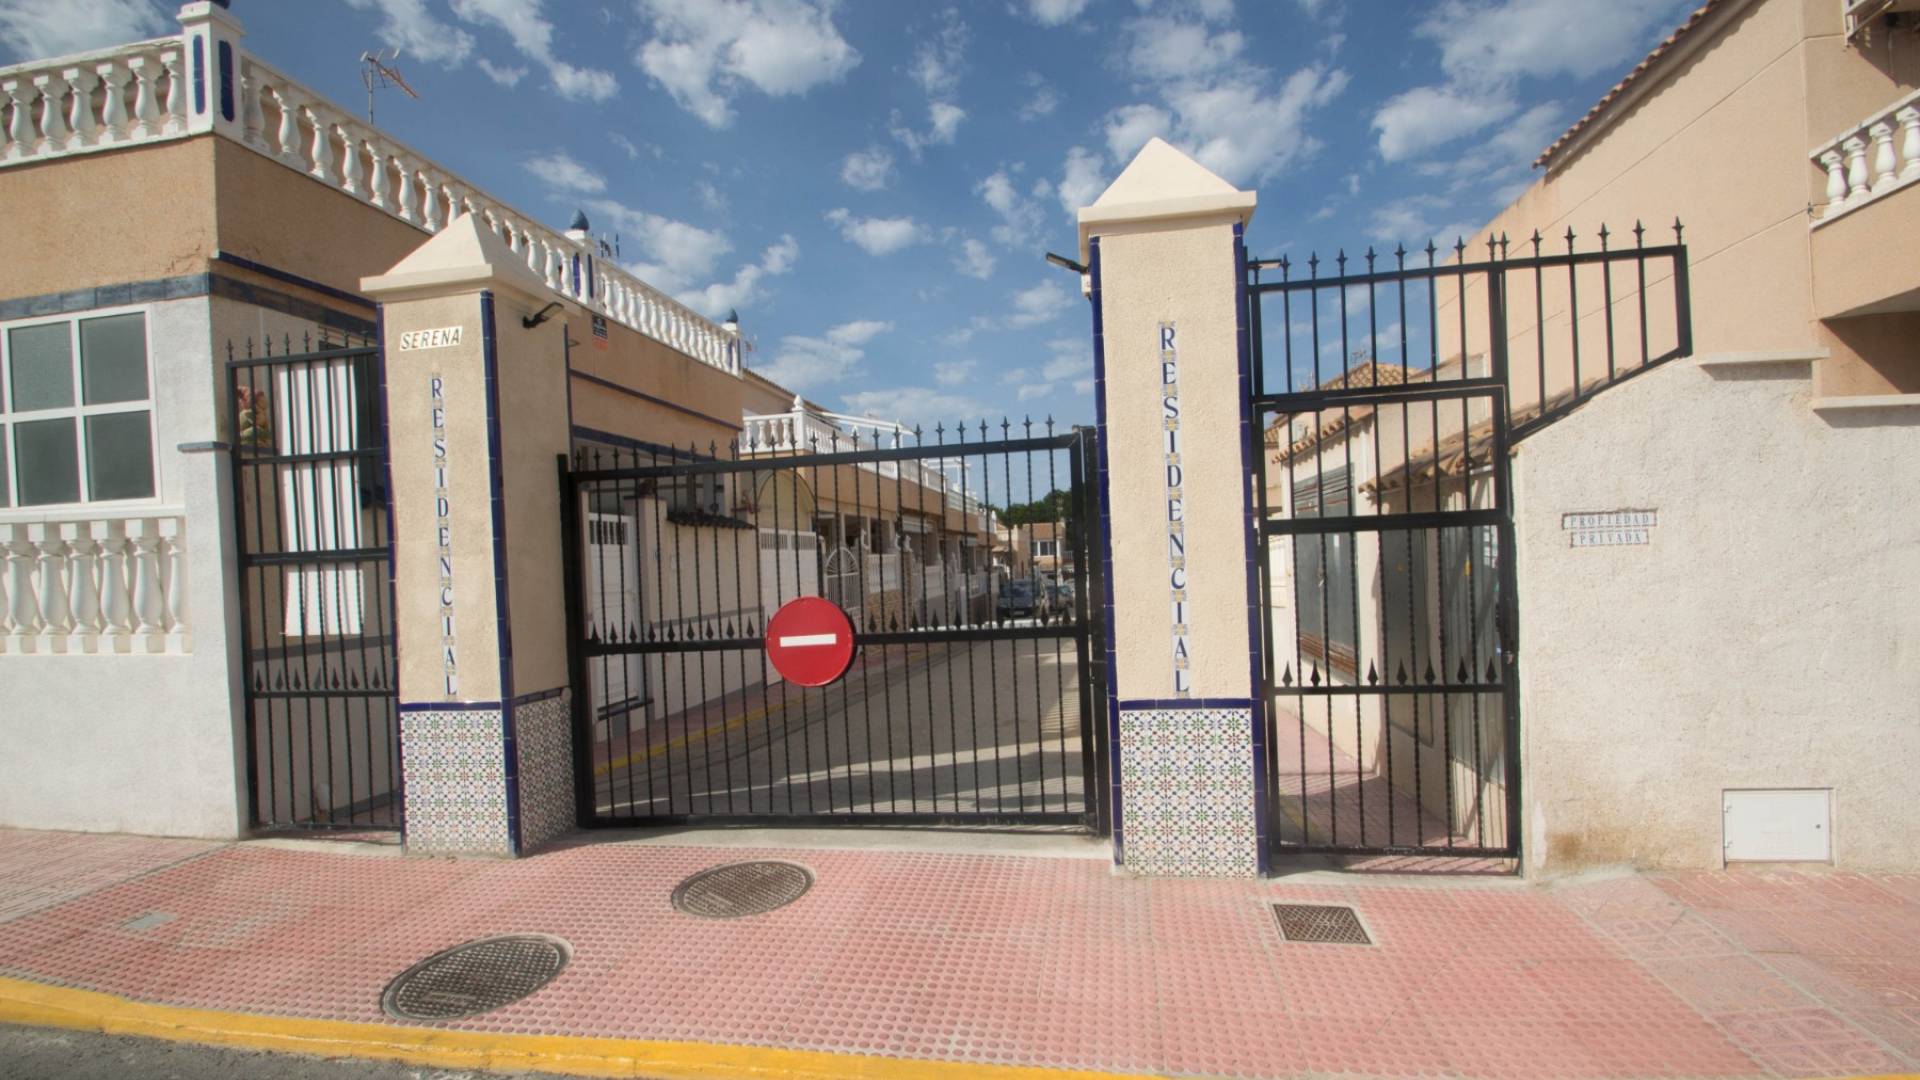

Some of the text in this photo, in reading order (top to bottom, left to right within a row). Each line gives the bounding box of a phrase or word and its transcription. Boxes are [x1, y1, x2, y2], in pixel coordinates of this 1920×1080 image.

[401, 328, 460, 350] SERENA
[1160, 327, 1189, 693] RESIDENCIAL
[1570, 513, 1650, 526] PROPIEDAD
[431, 377, 457, 696] RESIDENCIAL
[1580, 533, 1642, 545] PRIVADA
